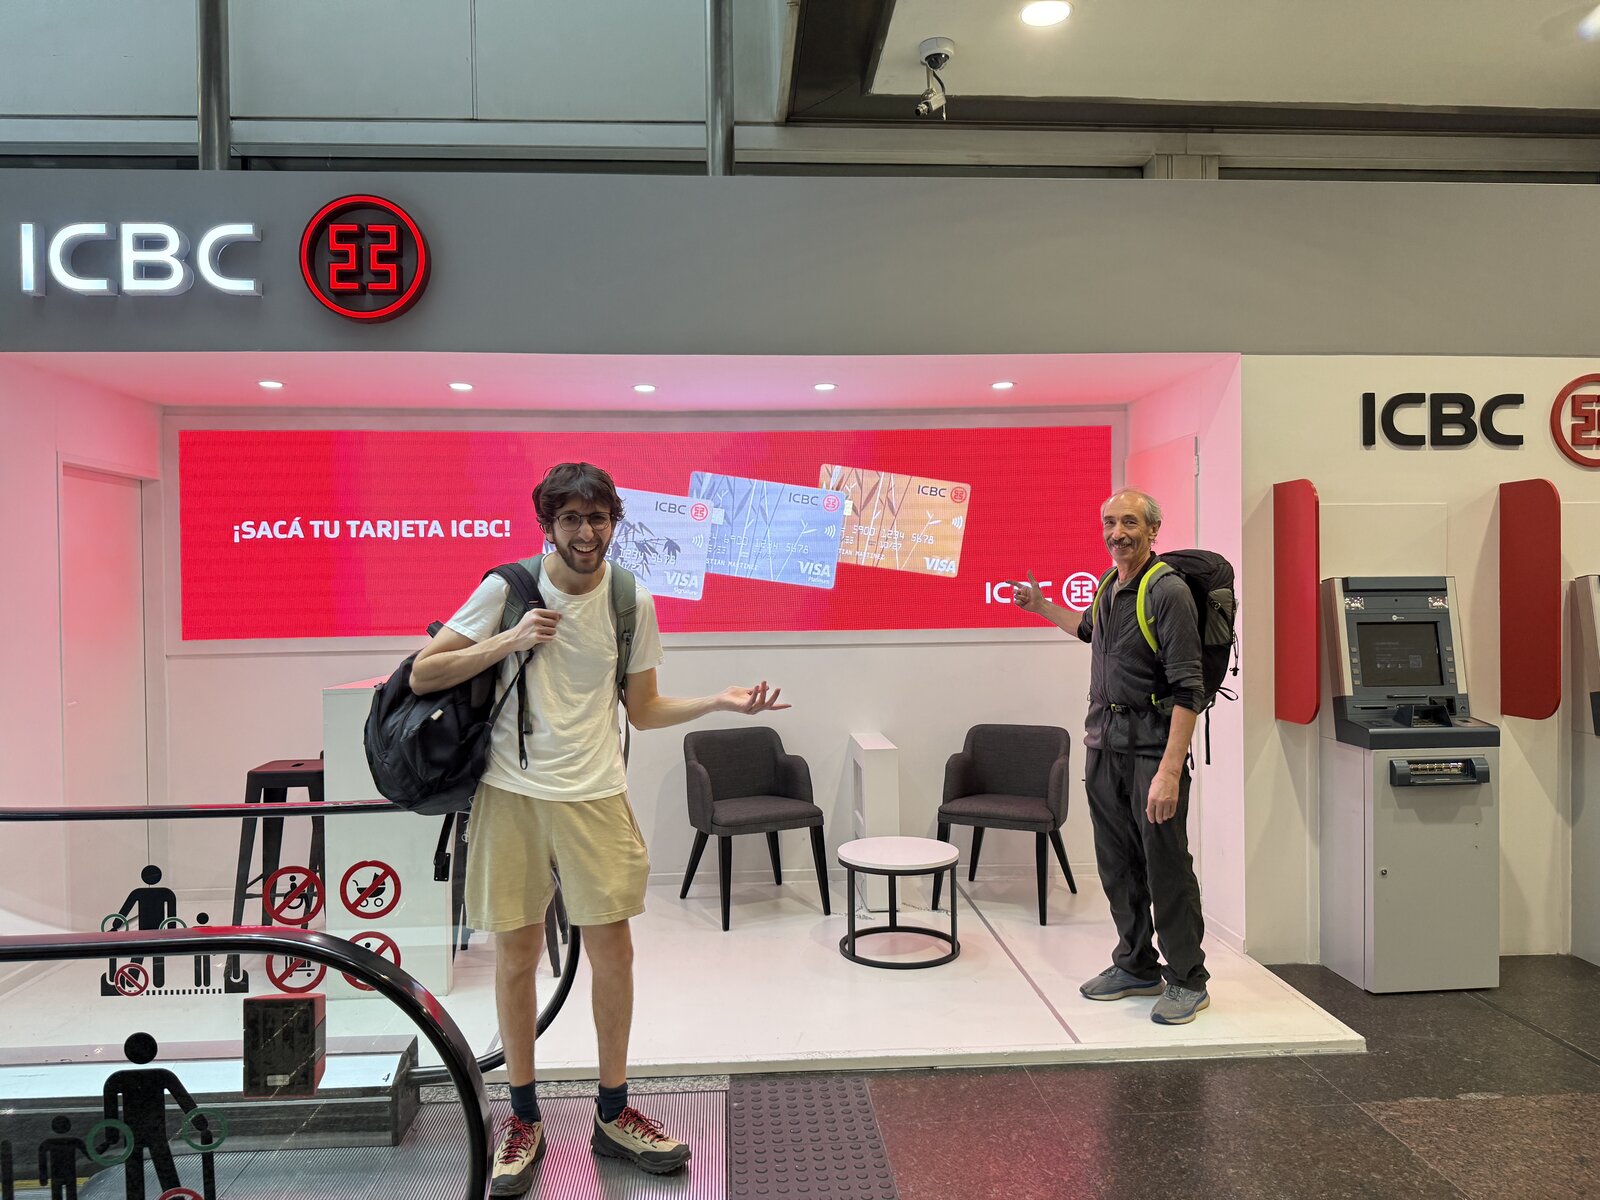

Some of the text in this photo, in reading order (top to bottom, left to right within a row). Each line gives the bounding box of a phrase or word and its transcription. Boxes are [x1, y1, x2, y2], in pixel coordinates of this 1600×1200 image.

[20, 222, 262, 297] ICBC
[1362, 392, 1524, 447] ICBC
[788, 492, 819, 506] ICBC
[917, 484, 948, 498] ICBC
[655, 500, 687, 515] ICBC
[233, 517, 511, 543] ¡SACÁ TU TARJETA ICBC!
[798, 560, 831, 577] VISA
[923, 557, 957, 574] VISA
[664, 570, 699, 588] VISA
